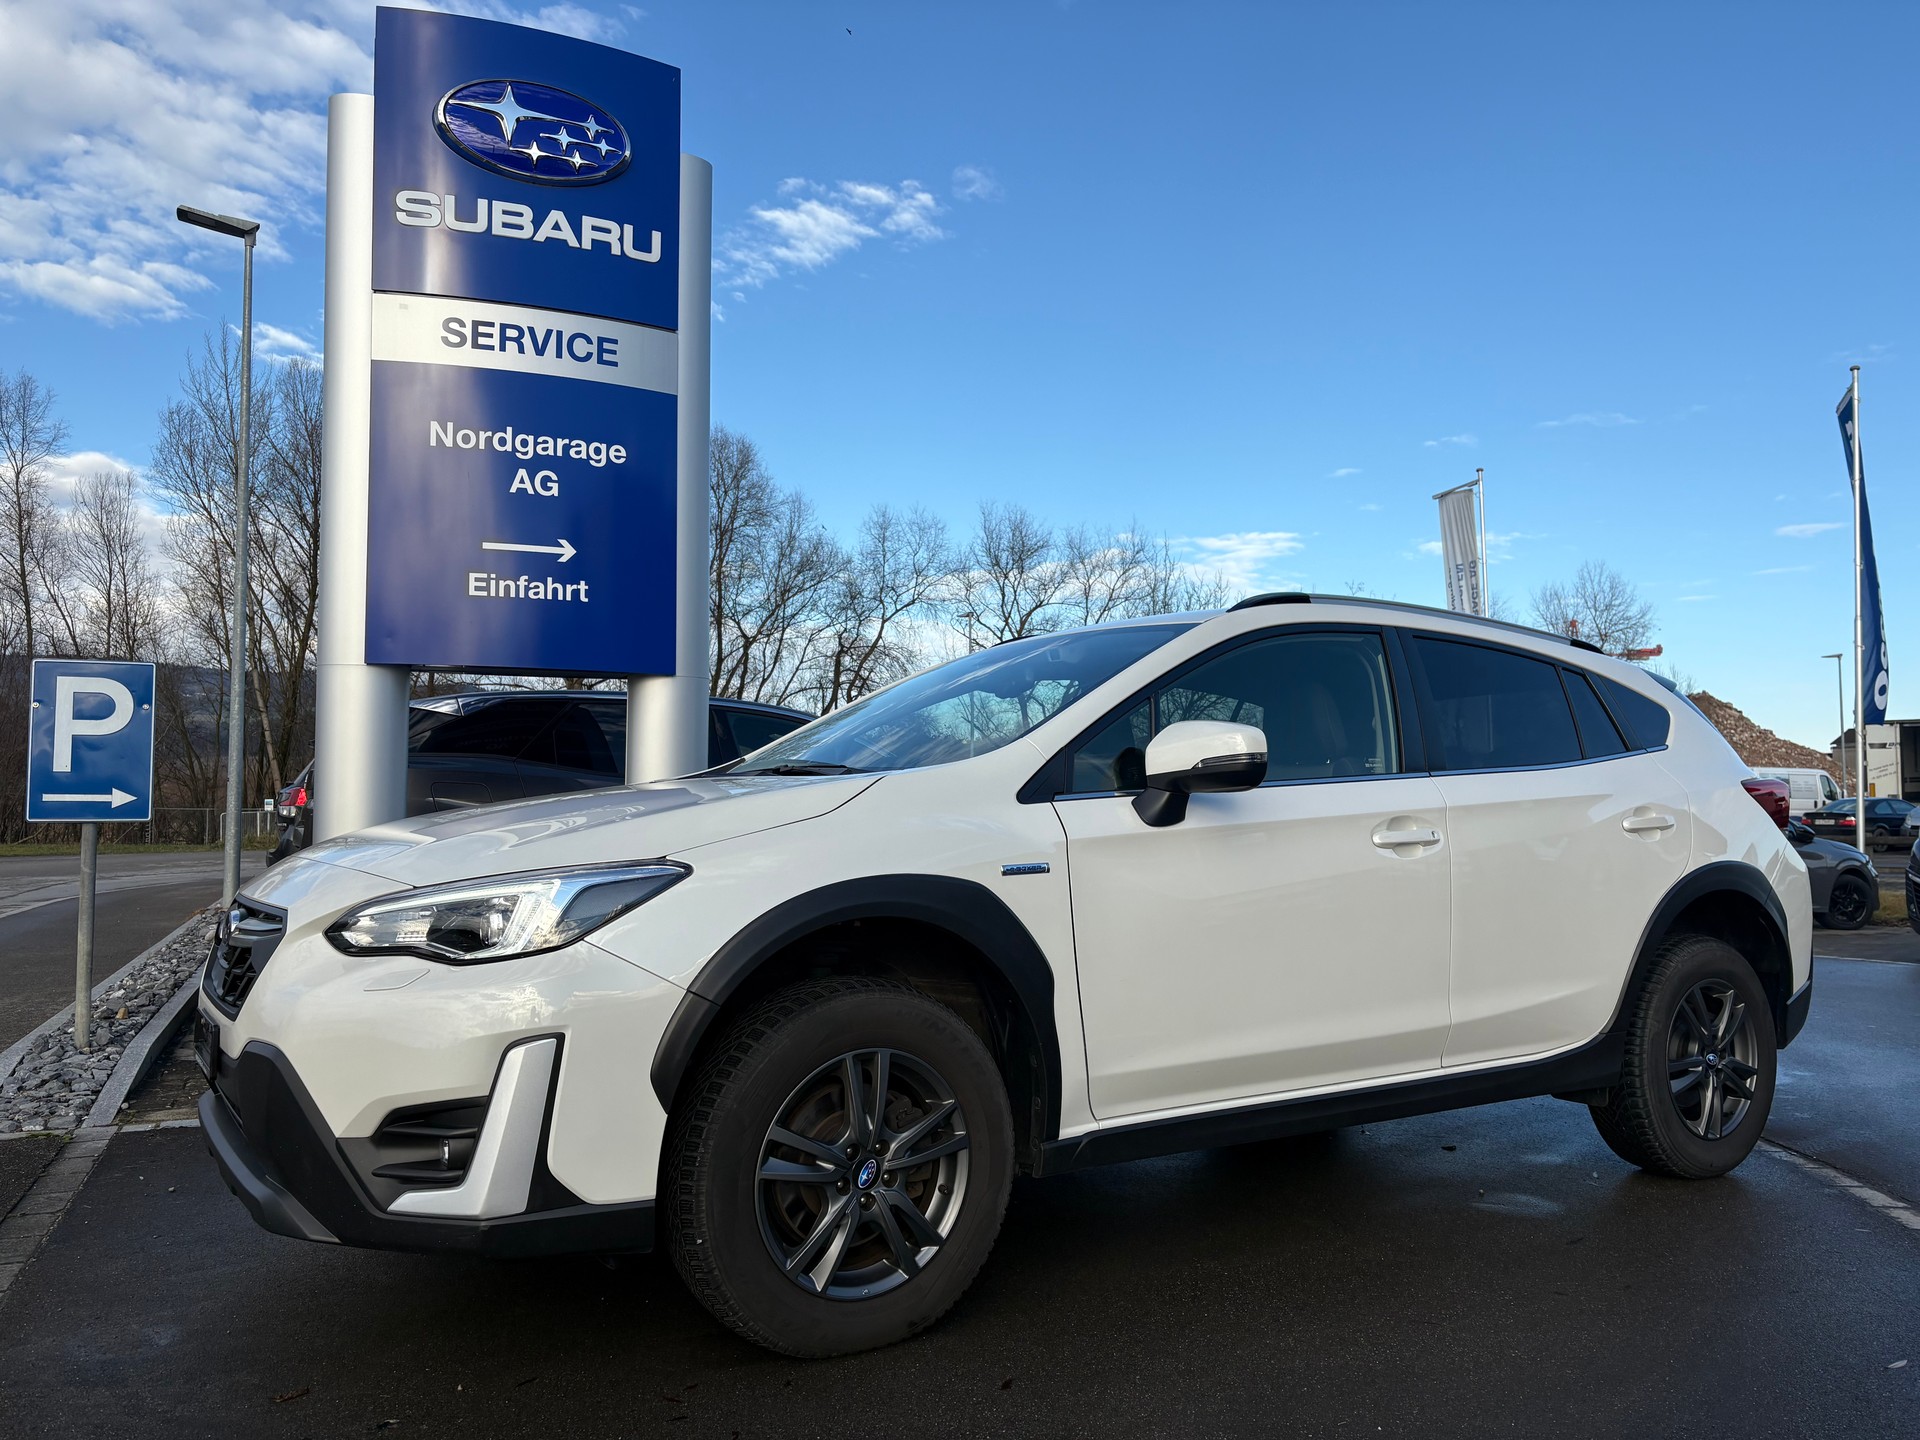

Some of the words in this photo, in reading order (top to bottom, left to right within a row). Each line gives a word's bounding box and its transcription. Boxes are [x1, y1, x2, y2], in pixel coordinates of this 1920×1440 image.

[395, 190, 662, 263] SUBARU
[440, 317, 619, 368] SERVICE
[430, 421, 627, 468] Nordgarage
[509, 468, 559, 497] AG
[468, 572, 589, 603] Einfahrt
[53, 676, 134, 773] P
